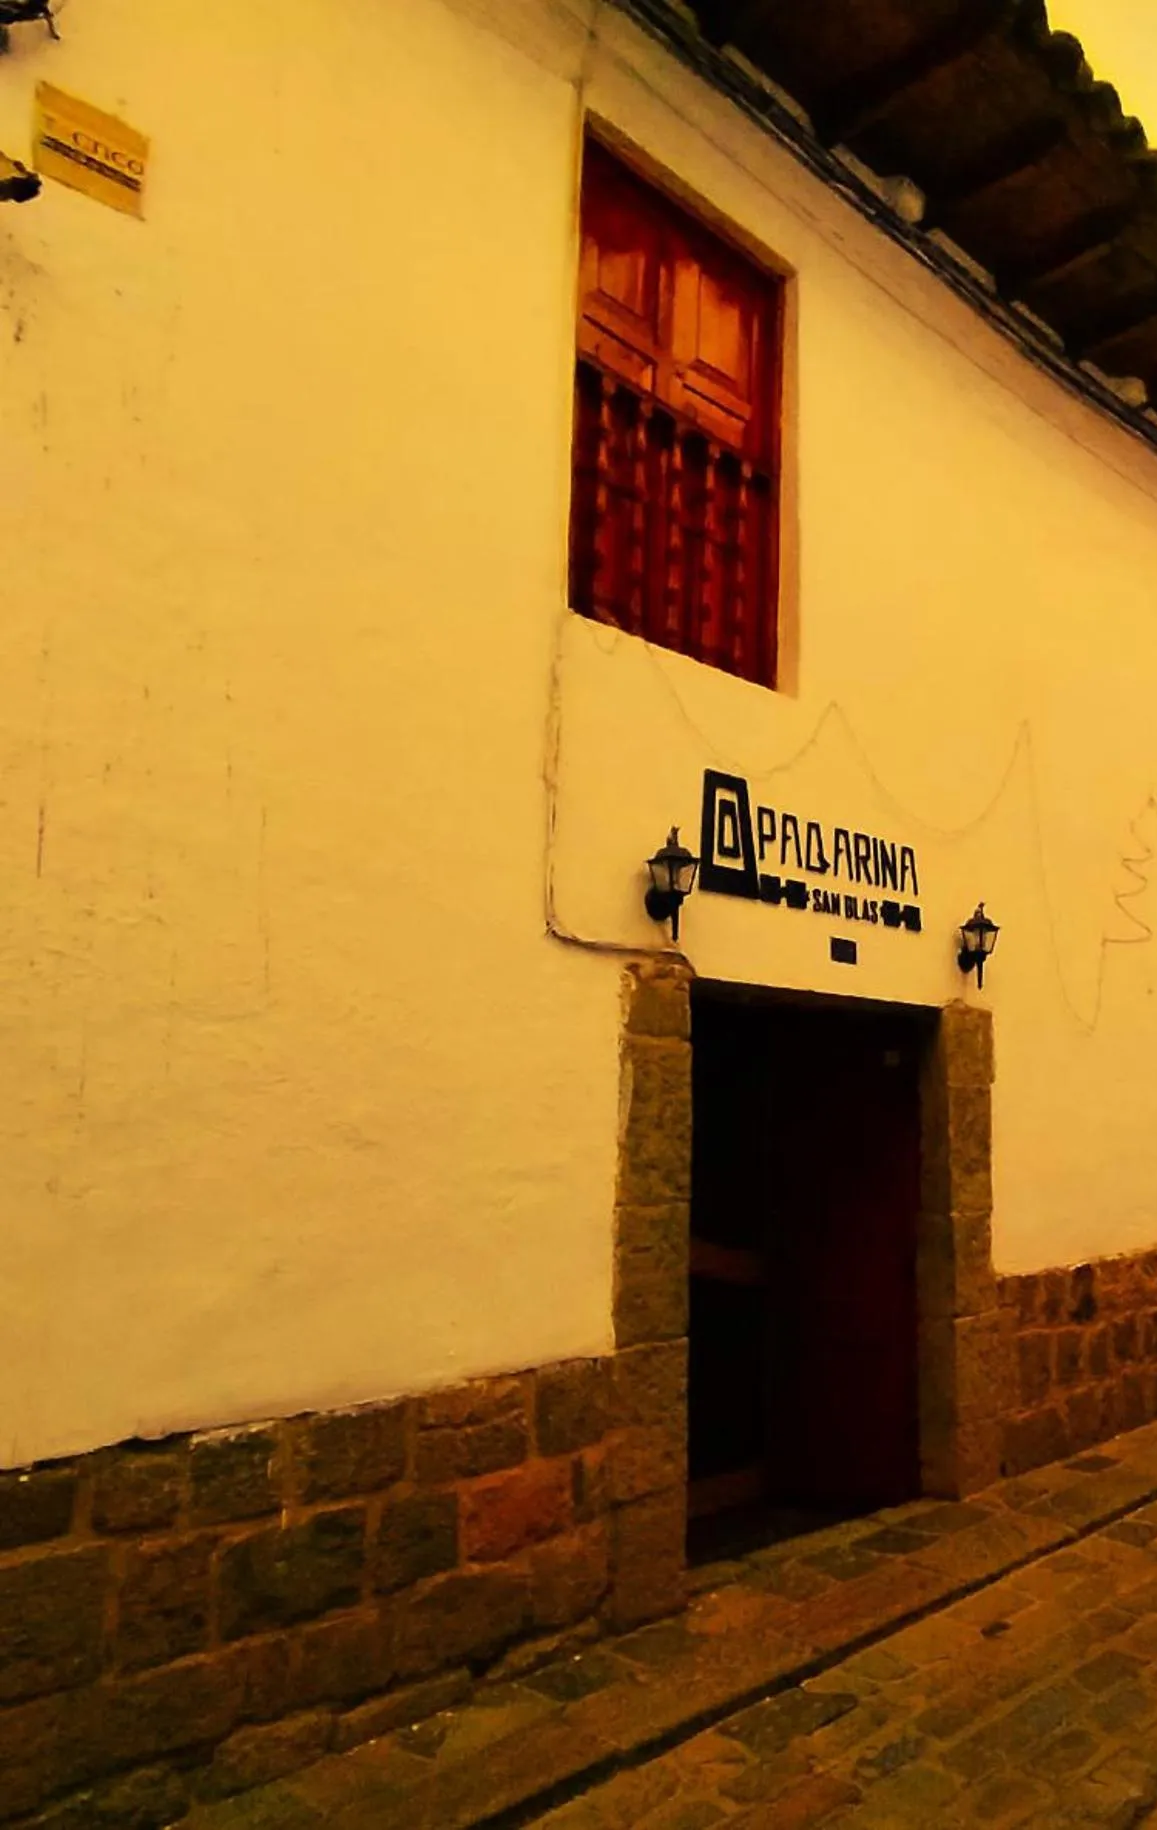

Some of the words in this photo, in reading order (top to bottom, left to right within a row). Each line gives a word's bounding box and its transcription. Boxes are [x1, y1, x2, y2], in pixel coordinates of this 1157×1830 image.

[756, 805, 919, 896] PAQARINA
[812, 888, 841, 916] SAN
[844, 894, 878, 924] BLAS
